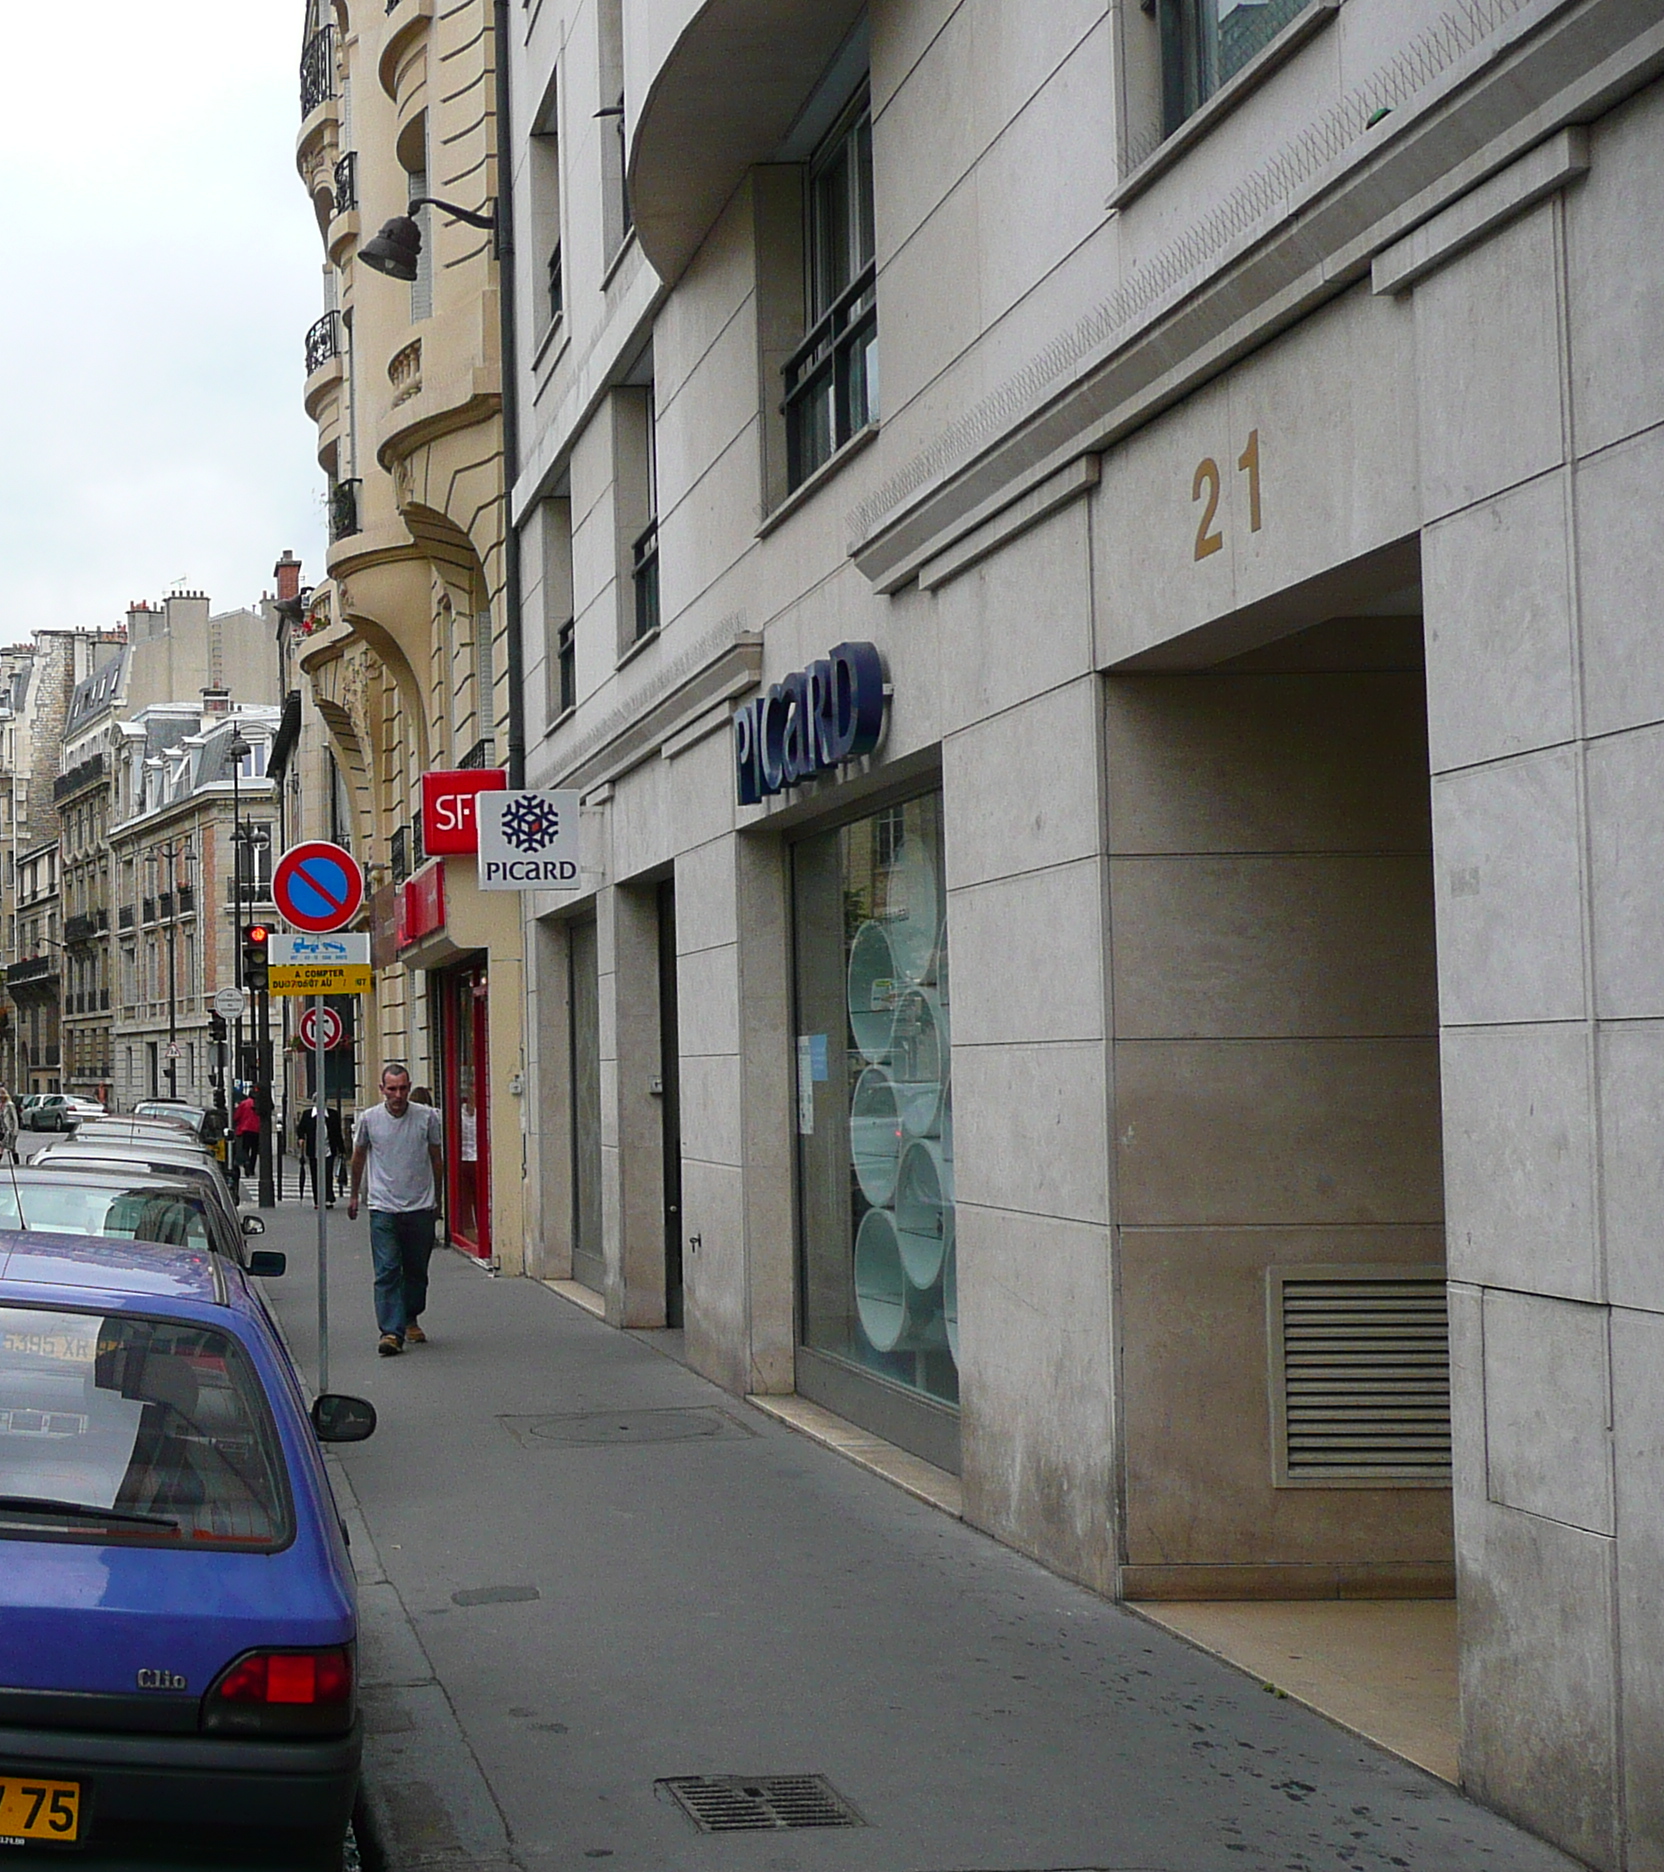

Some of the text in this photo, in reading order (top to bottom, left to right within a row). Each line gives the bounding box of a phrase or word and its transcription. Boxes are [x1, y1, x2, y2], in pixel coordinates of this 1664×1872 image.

[1192, 428, 1261, 562] 21
[436, 794, 477, 830] SF
[304, 969, 344, 978] COMPTER
[137, 1668, 186, 1690] Clio
[21, 1786, 76, 1832] 75
